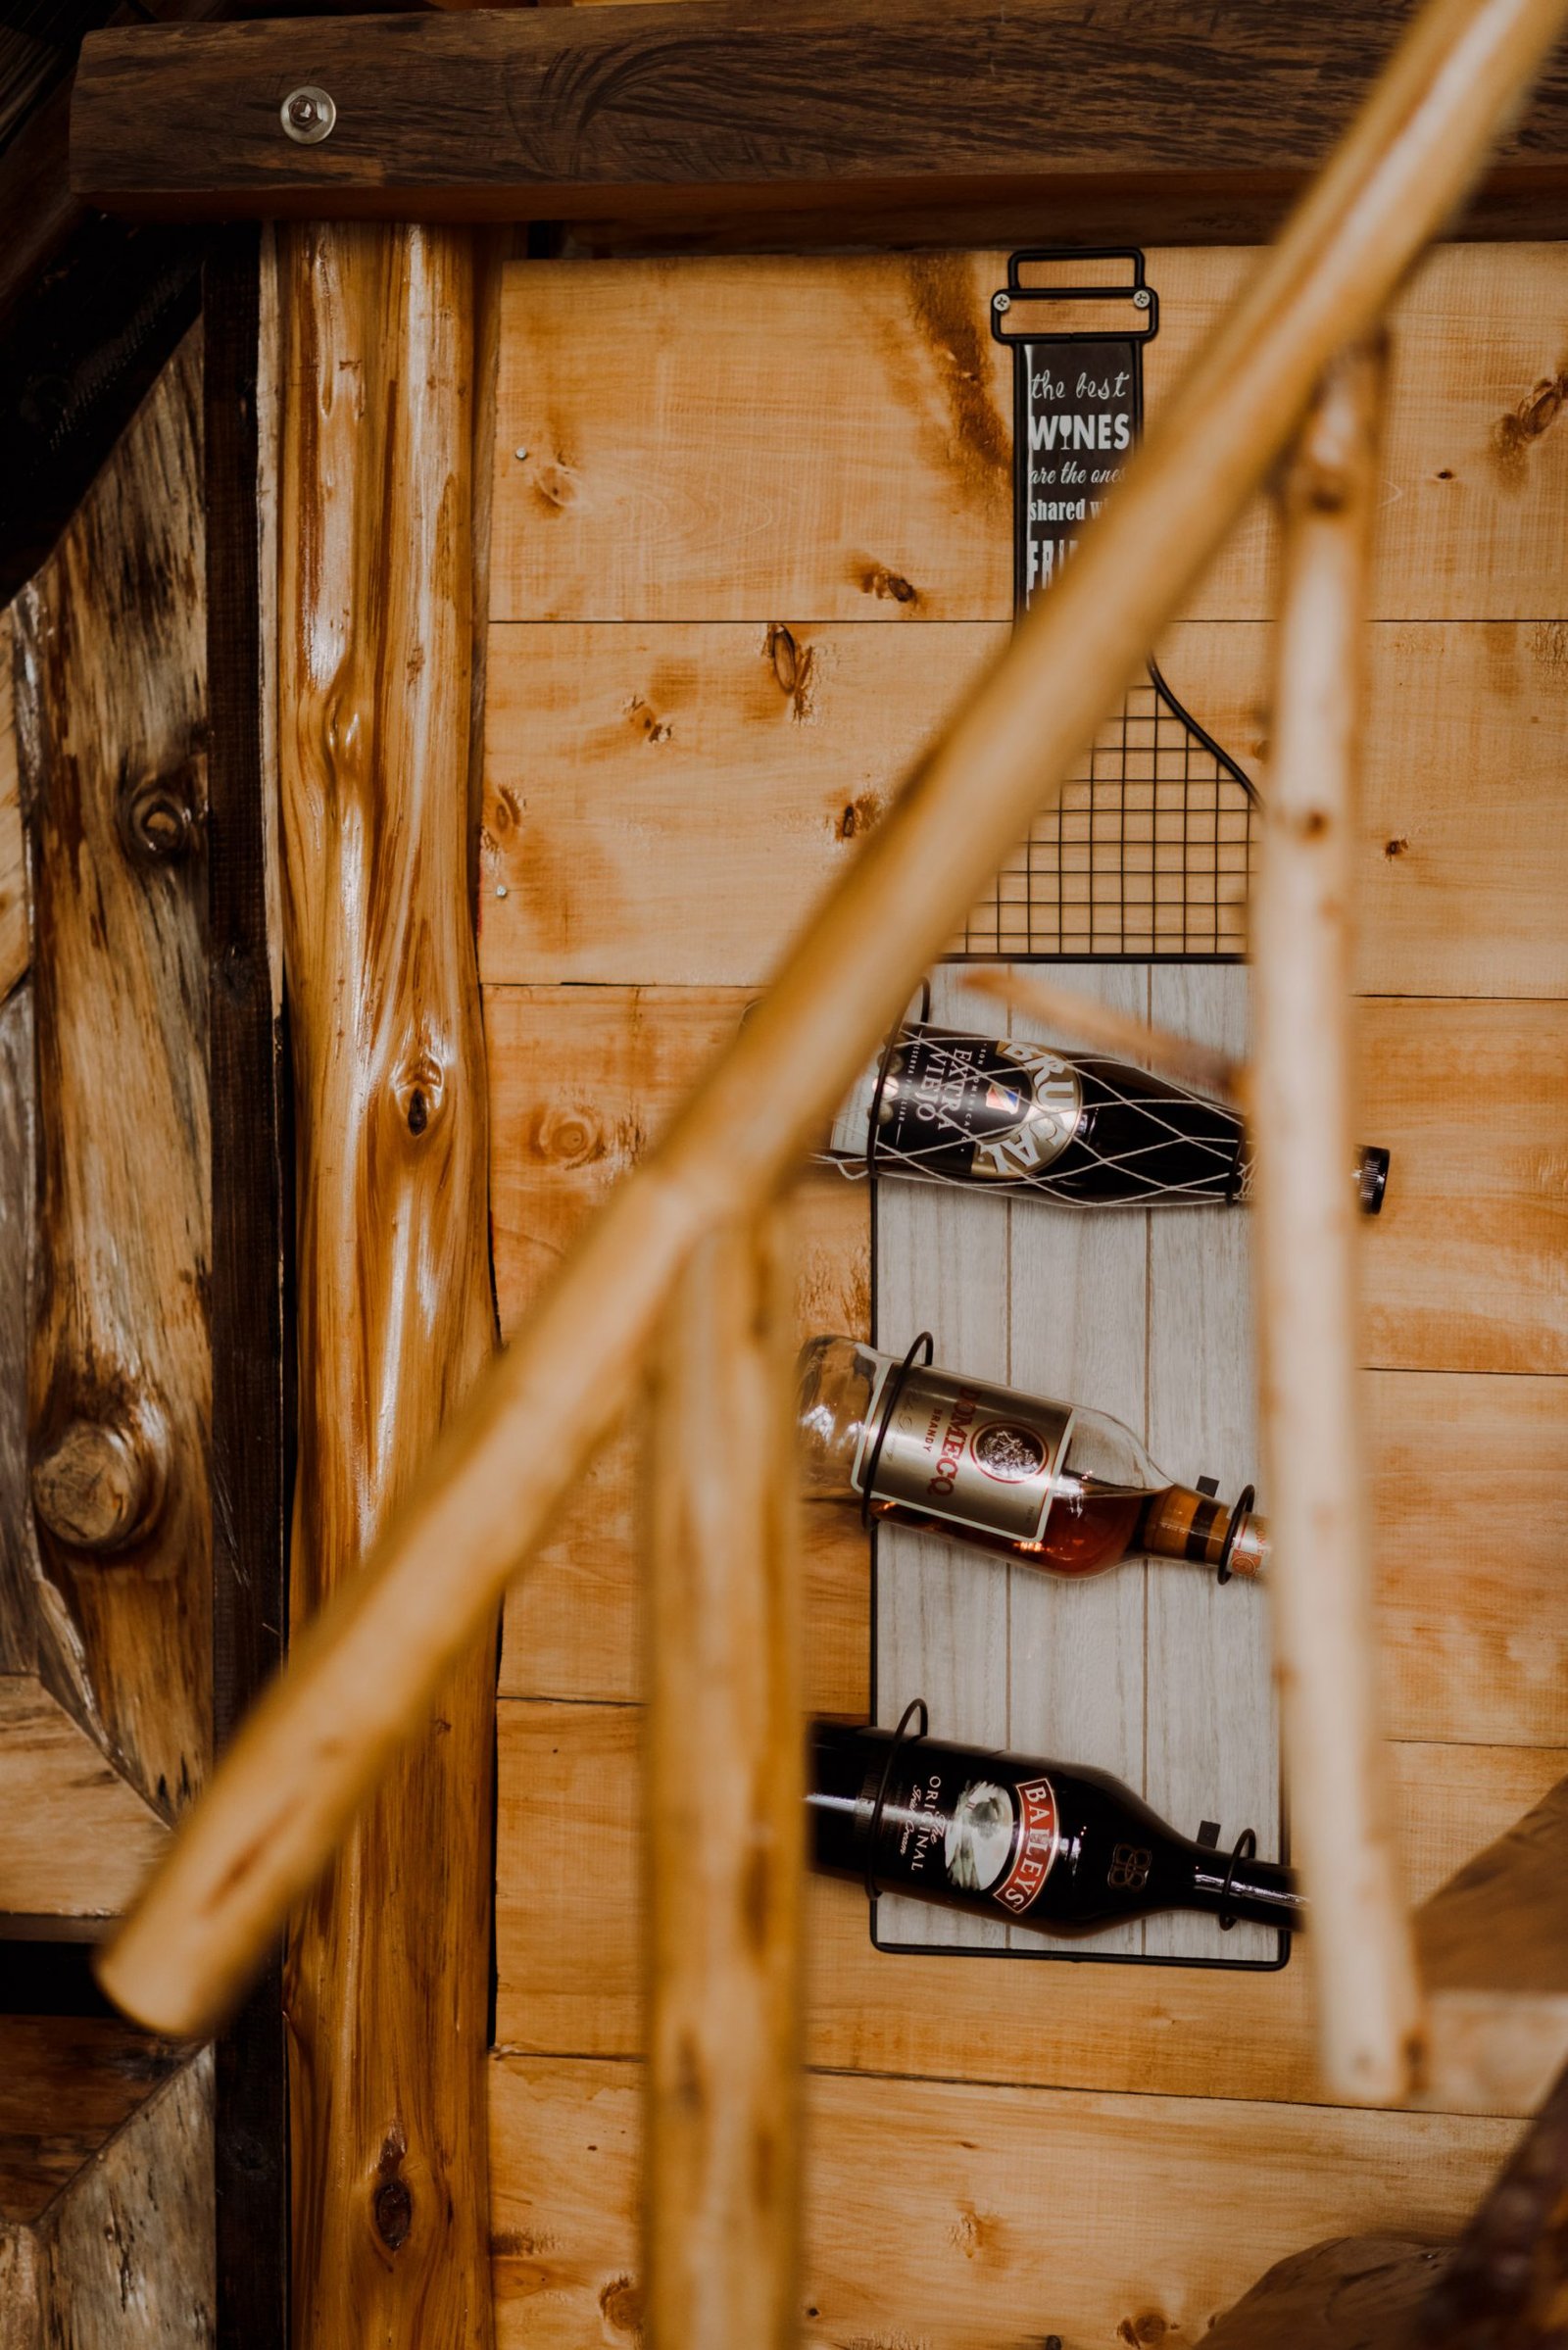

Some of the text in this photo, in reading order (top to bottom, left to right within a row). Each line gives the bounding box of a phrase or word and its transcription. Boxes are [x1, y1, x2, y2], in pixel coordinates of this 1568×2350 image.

[1030, 369, 1130, 400] the best
[1030, 466, 1056, 484] are
[1060, 461, 1087, 484] the
[1030, 498, 1086, 521] shared
[914, 1051, 950, 1122] VIEJO
[938, 1048, 973, 1131] EXTRA
[921, 1407, 944, 1453] BRANDY
[927, 1386, 981, 1497] DOMECQ
[900, 1819, 915, 1856] Cream
[910, 1775, 942, 1872] ORIGINAL
[1004, 1785, 1051, 1906] BAILEYS
